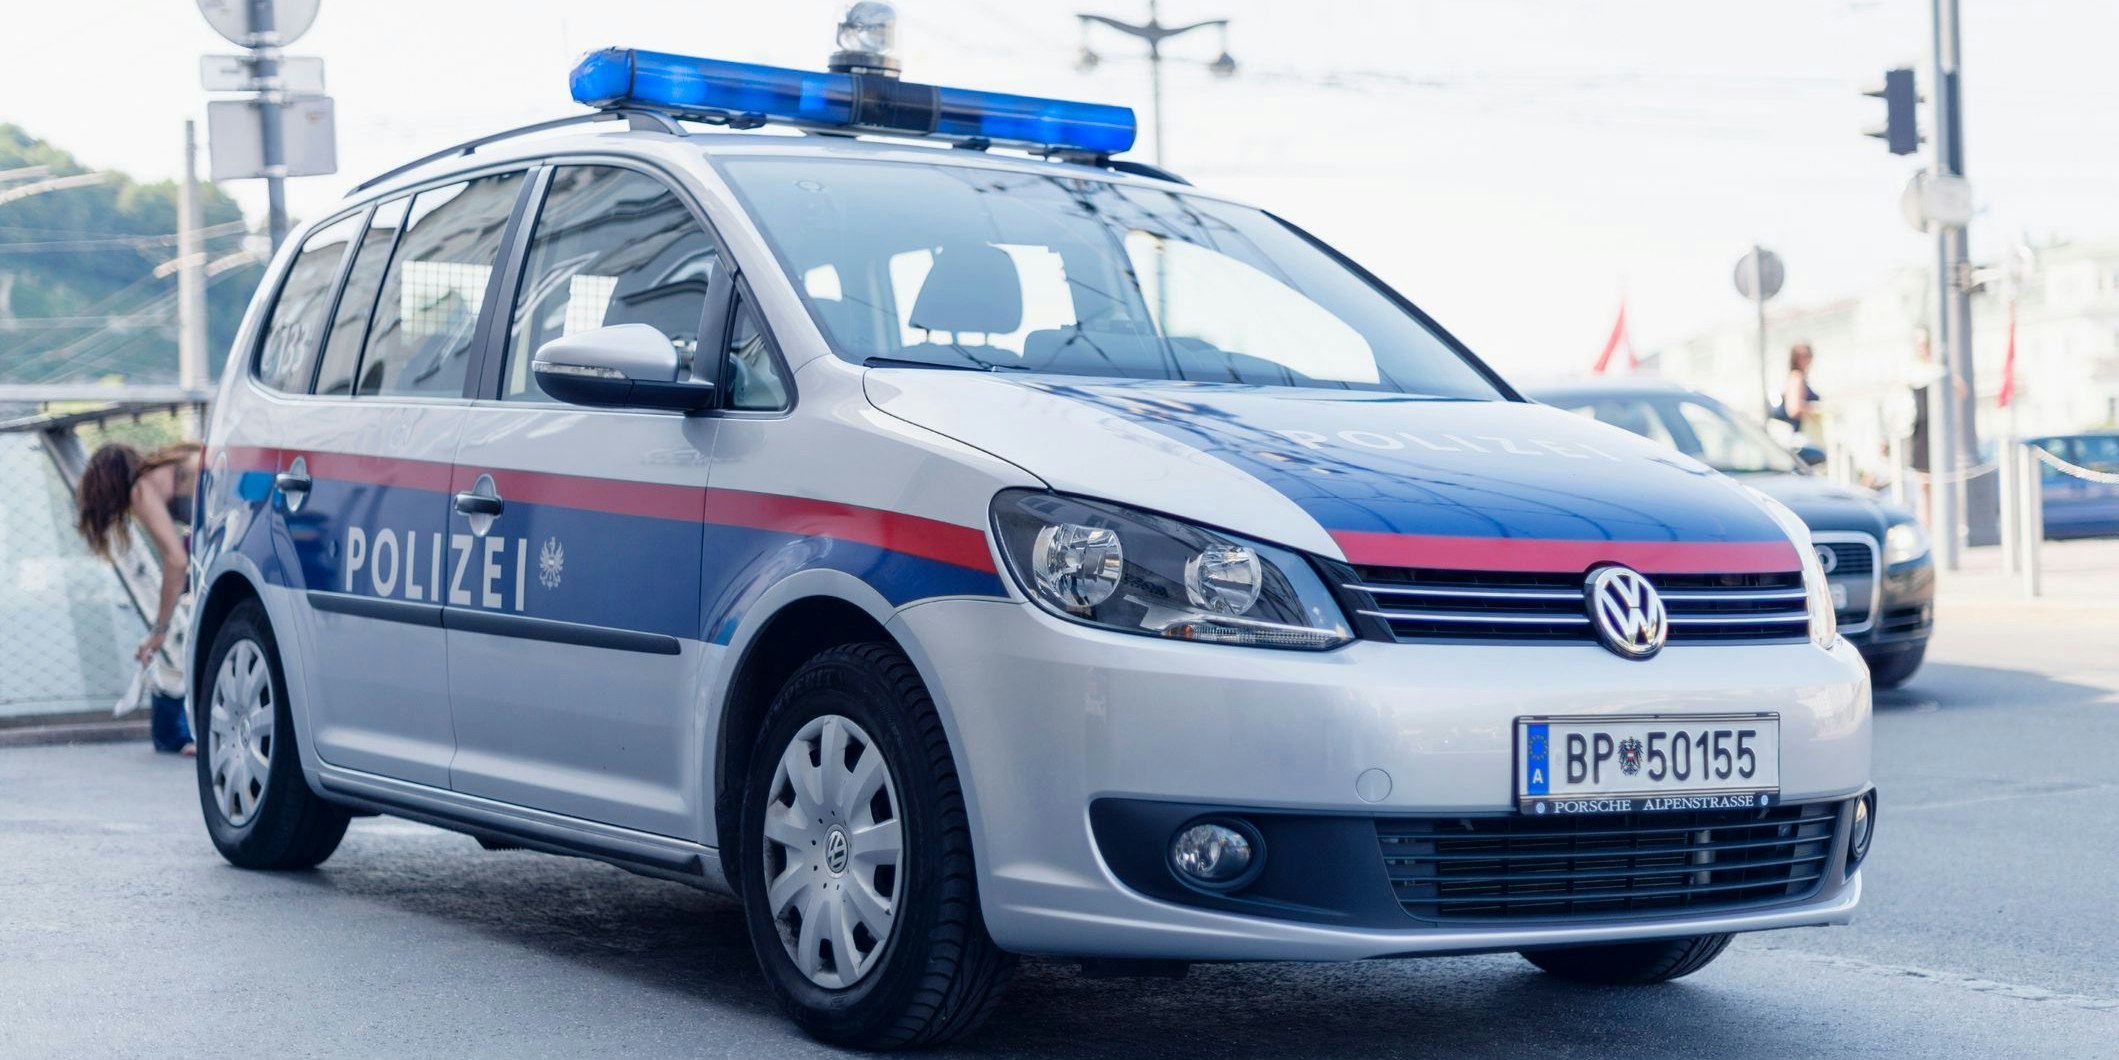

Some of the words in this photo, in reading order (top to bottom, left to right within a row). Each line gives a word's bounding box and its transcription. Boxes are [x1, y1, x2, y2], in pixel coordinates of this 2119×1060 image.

[1273, 429, 1623, 462] POLIZEI
[345, 526, 527, 611] POLIZEI
[1593, 566, 1668, 654] VW
[1532, 768, 1544, 785] A
[1566, 732, 1615, 785] BP
[1647, 730, 1757, 782] 50155
[1553, 799, 1632, 814] PORSCHE
[1642, 795, 1755, 812] ALPENSTRASSE
